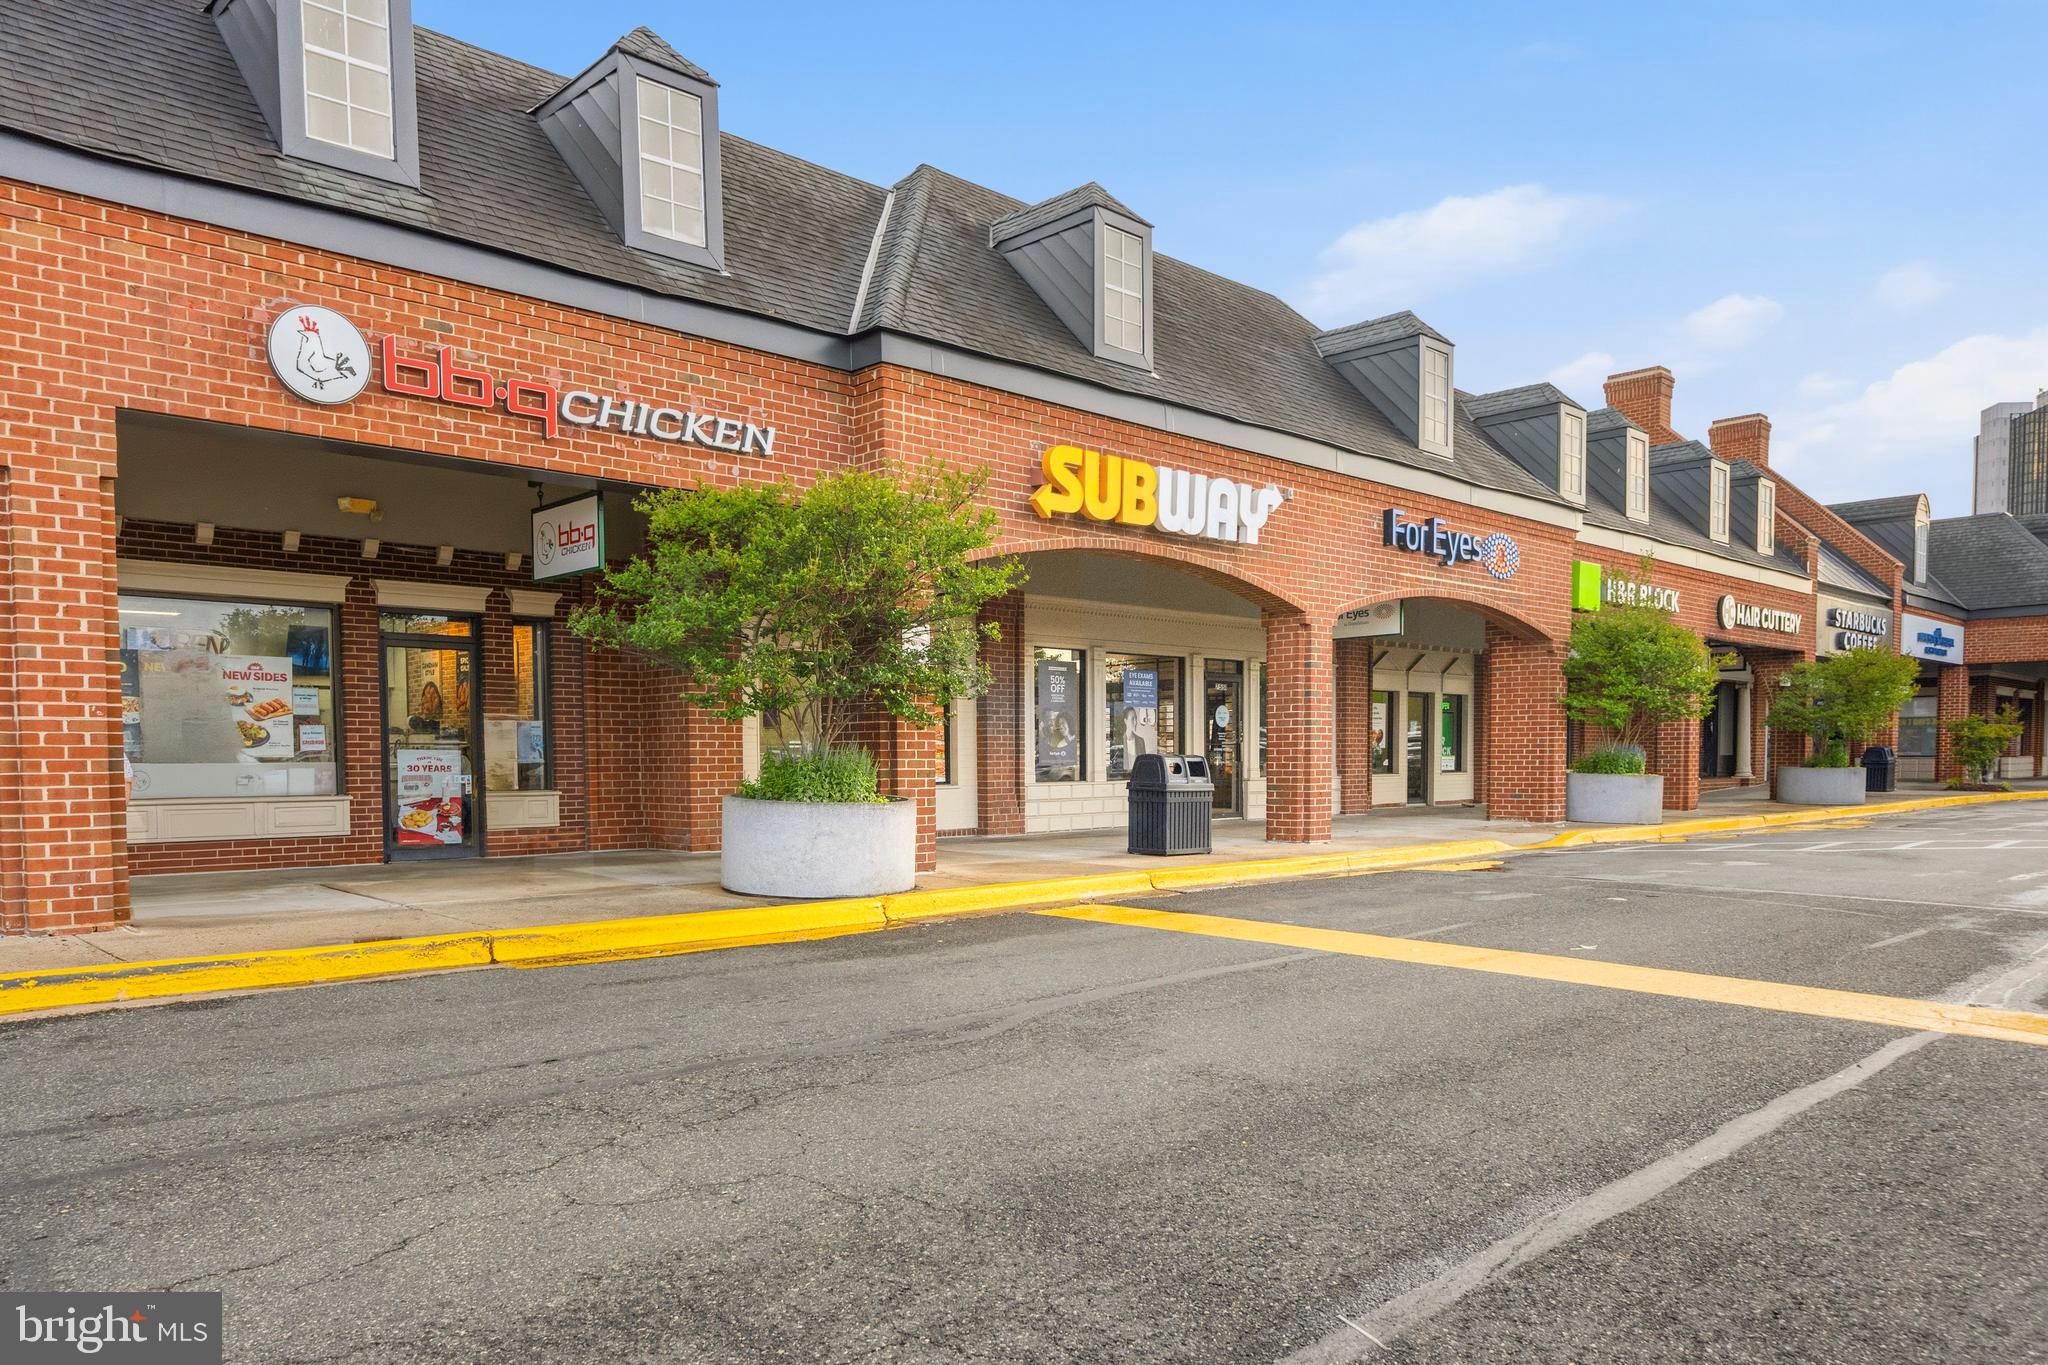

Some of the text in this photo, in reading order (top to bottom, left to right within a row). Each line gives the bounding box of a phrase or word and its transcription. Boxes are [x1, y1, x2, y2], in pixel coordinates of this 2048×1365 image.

[560, 389, 776, 457] CHICKEN
[1029, 444, 1285, 545] SUBWAY
[561, 541, 591, 556] CHICKEN
[1388, 508, 1482, 566] For Eyes
[1607, 578, 1680, 613] H&R BLOCK
[1736, 603, 1801, 635] HAIR CUTTERY
[1834, 608, 1887, 636] STARBUCKS
[223, 670, 288, 682] NEW SIDES
[1050, 675, 1066, 684] 50%
[1050, 684, 1065, 693] OFF
[407, 764, 452, 773] 30 YEARS
